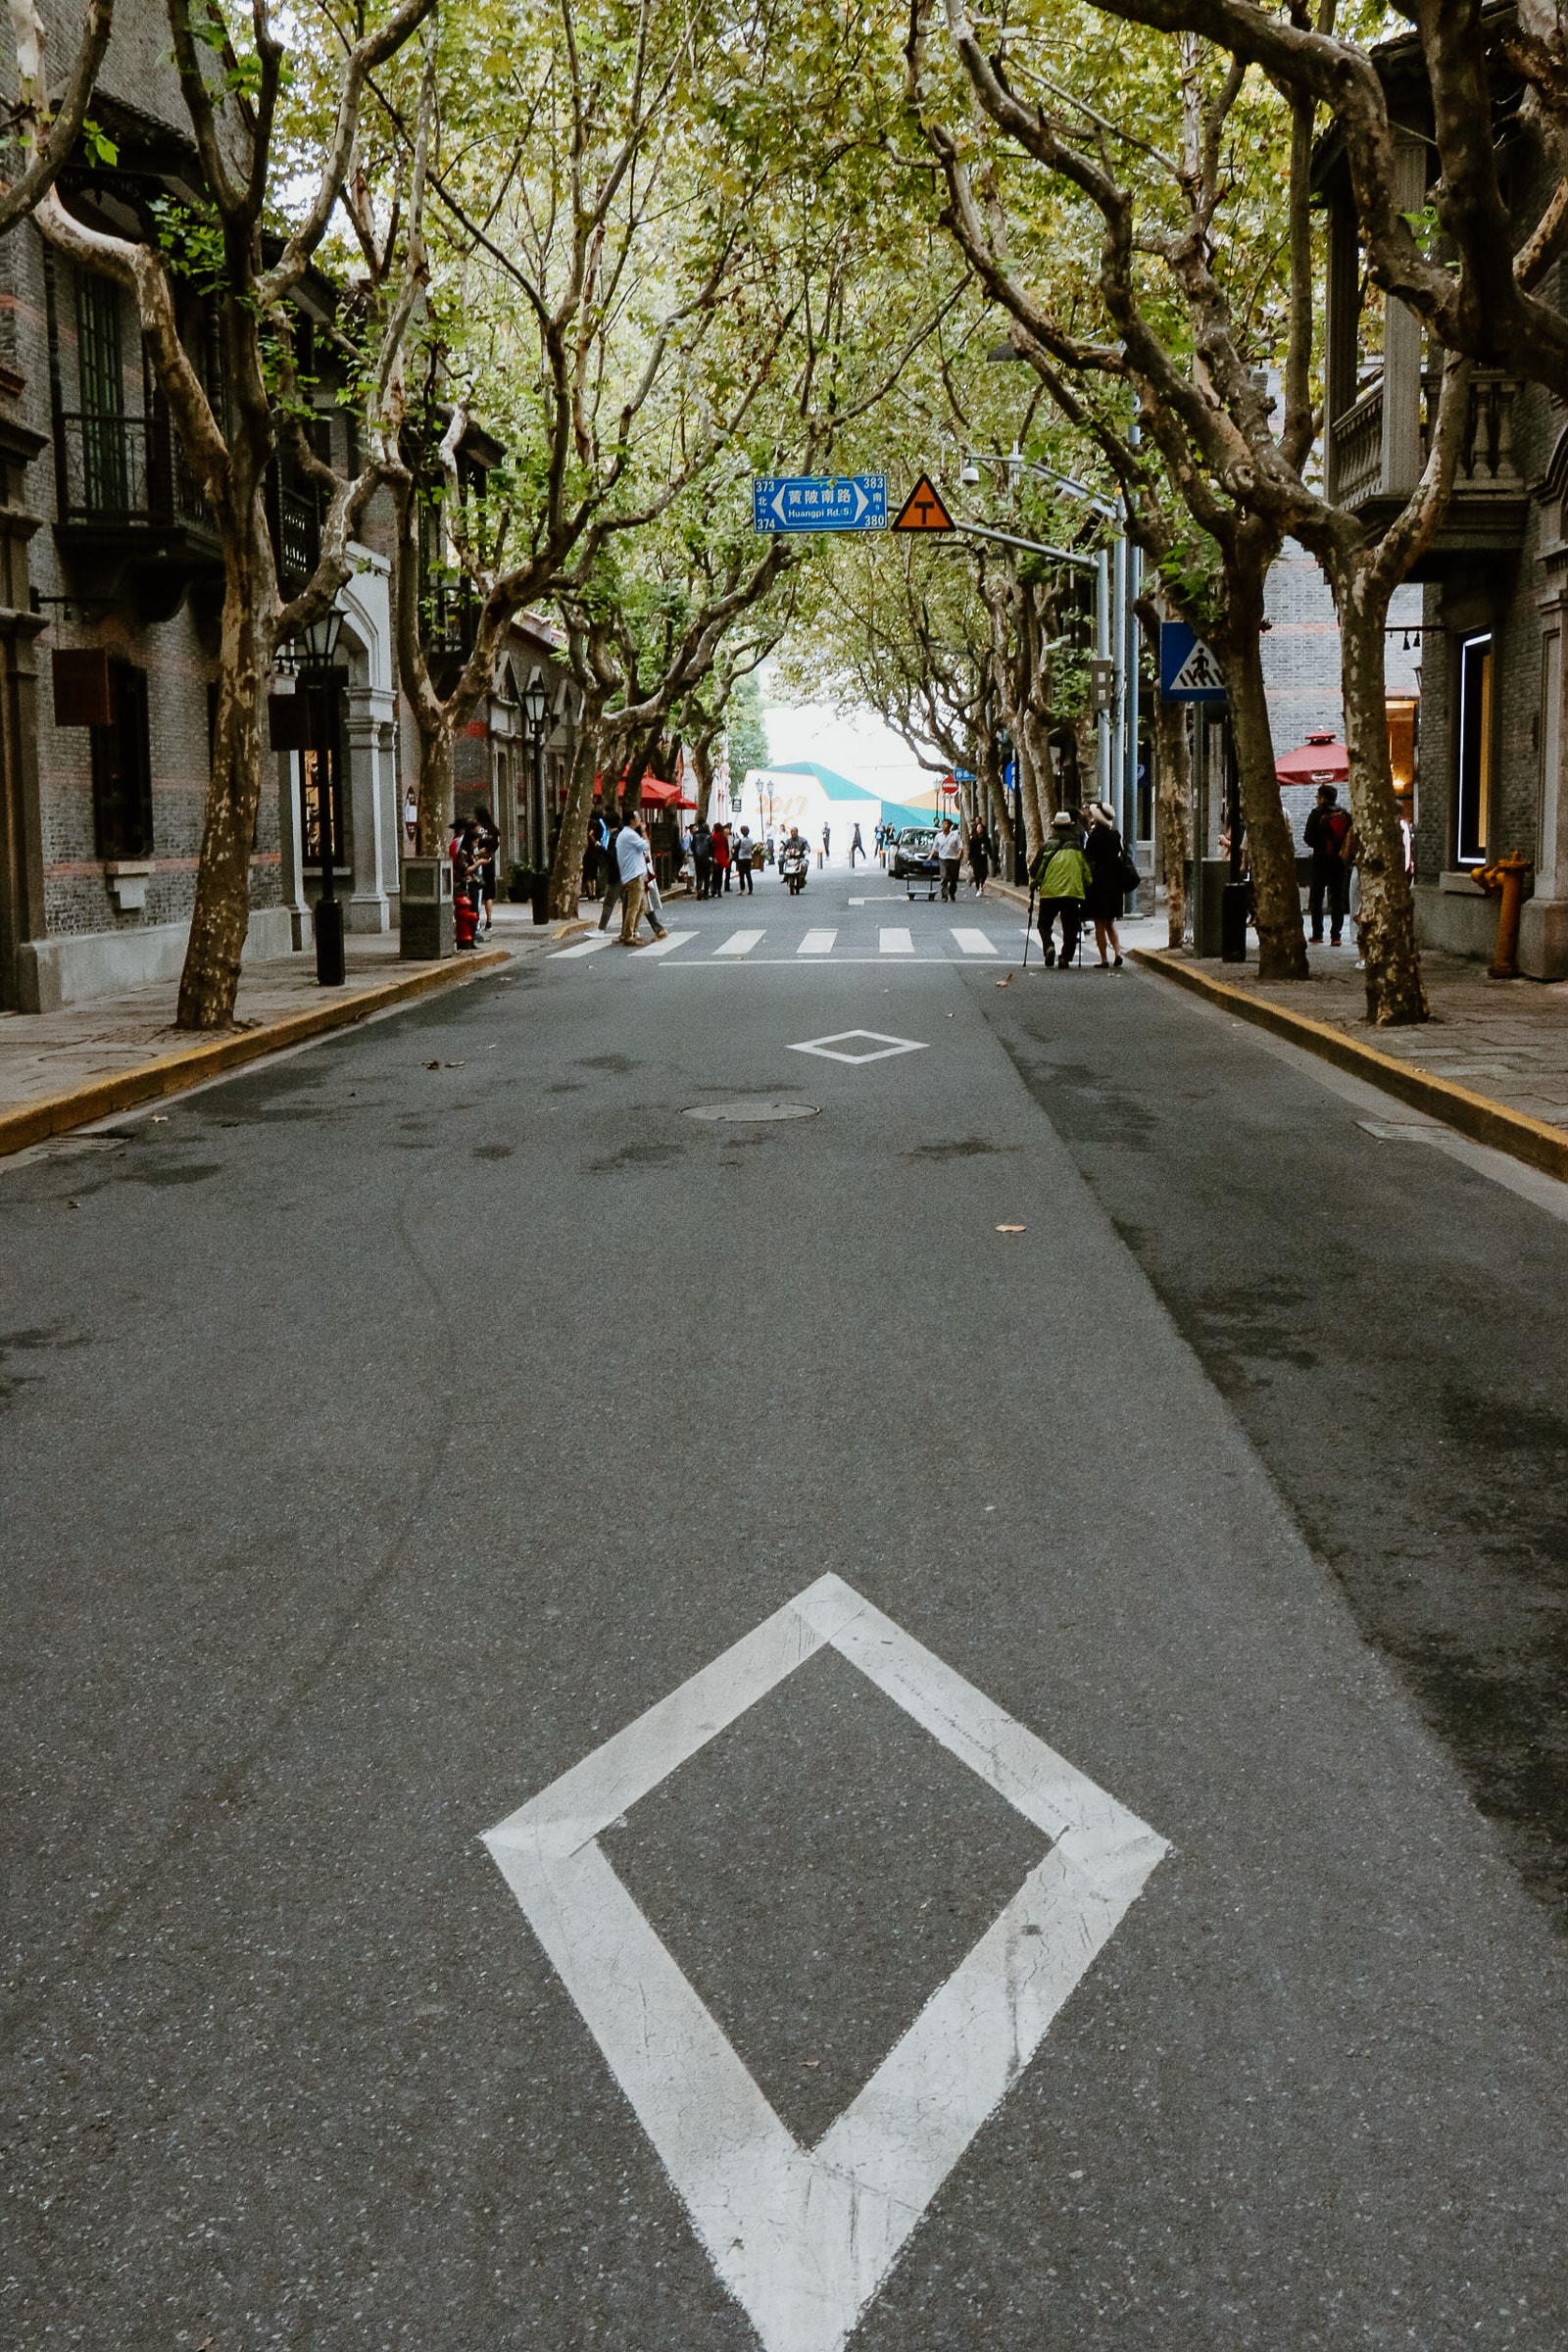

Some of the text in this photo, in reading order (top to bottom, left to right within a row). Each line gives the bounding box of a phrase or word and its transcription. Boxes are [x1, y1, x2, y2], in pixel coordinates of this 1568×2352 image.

[756, 480, 775, 493] 373
[863, 477, 884, 489] 383
[758, 496, 767, 507] 北
[872, 492, 882, 503] 南
[788, 509, 824, 519] Huangpi
[757, 517, 775, 530] 374
[864, 514, 885, 527] 380
